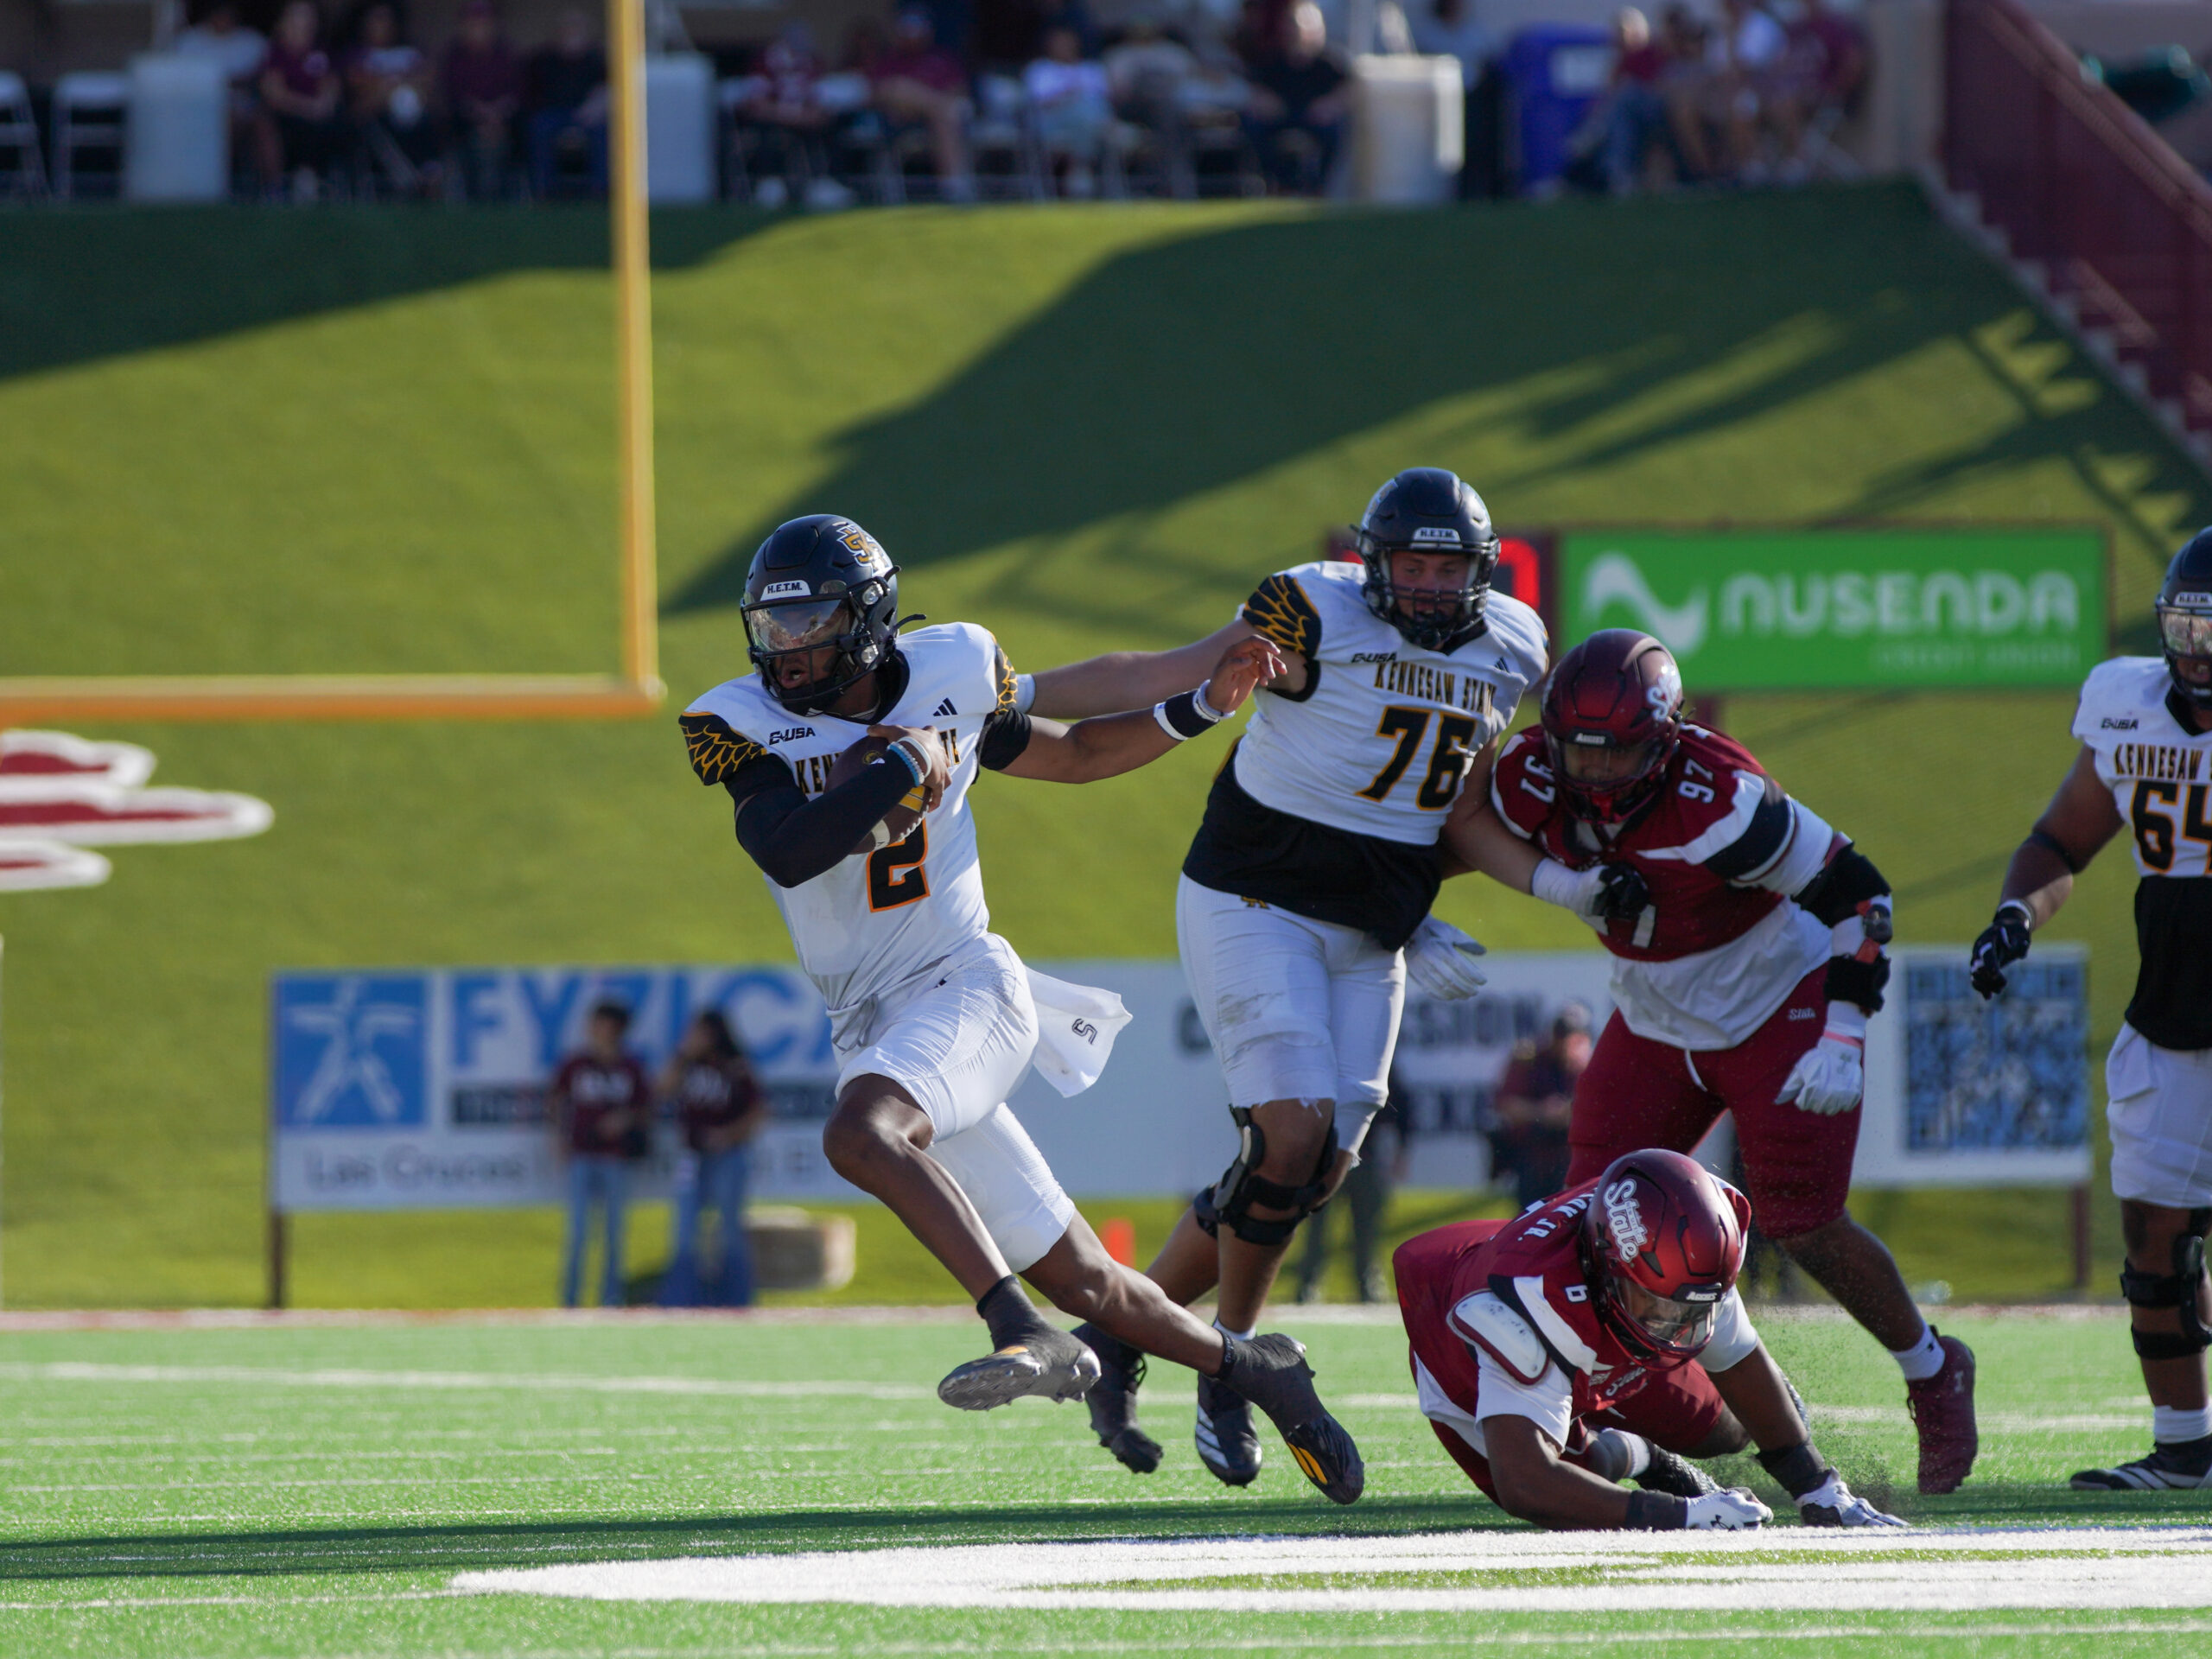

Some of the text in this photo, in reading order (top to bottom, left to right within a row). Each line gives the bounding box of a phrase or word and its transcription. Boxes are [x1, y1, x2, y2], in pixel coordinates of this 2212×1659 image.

[766, 582, 803, 594] H.E.T.M.
[1374, 660, 1456, 705] KENNESAW
[1354, 705, 1478, 811] 76
[1677, 758, 1715, 804] 97
[2114, 742, 2203, 781] KENNESAW
[2129, 779, 2212, 875] 64
[866, 817, 931, 913] 2
[1605, 1179, 1648, 1263] State
